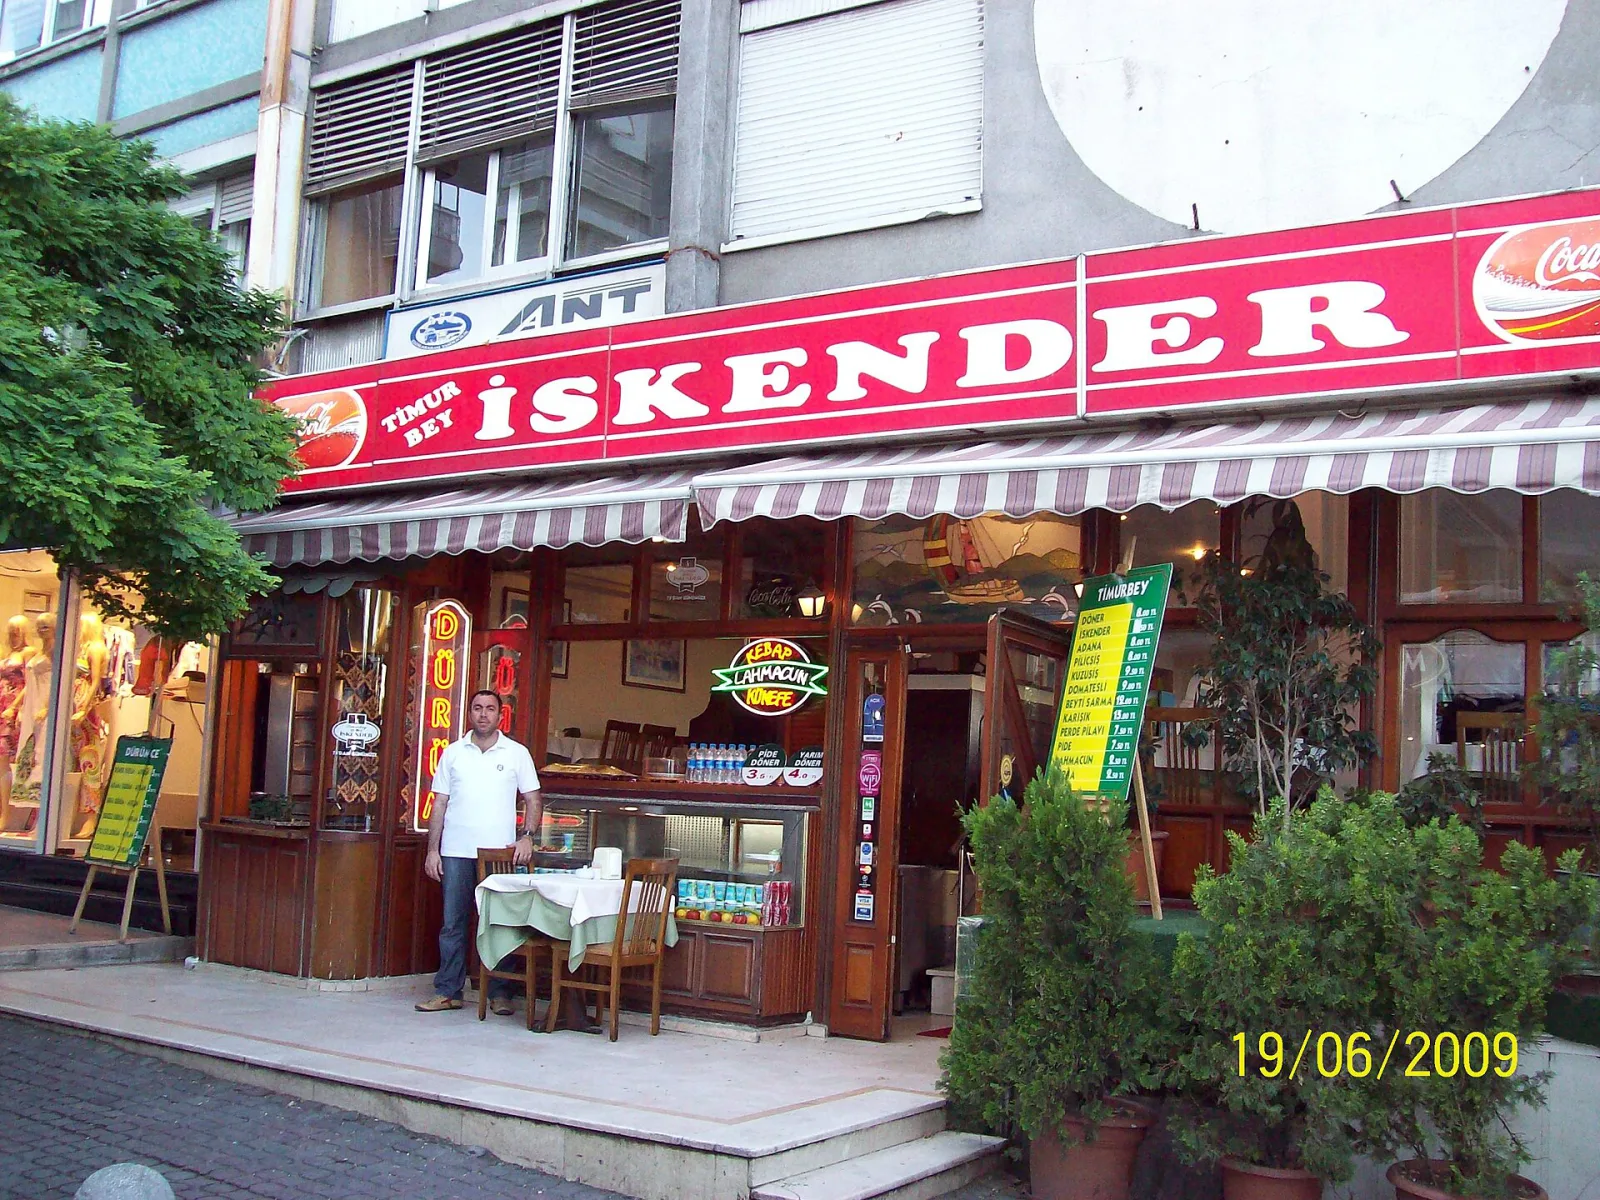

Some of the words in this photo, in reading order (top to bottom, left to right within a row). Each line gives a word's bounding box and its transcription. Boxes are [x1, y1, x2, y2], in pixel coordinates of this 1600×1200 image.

[497, 284, 651, 336] ANT
[403, 408, 453, 448] BEY
[746, 641, 793, 665] KEBAP
[1077, 643, 1102, 653] ADANA
[733, 665, 809, 685] LAHMACUN
[1061, 727, 1081, 737] PERDE
[758, 748, 779, 758] PİDE
[750, 757, 780, 767] DÖNER
[794, 757, 822, 767] DÖNER
